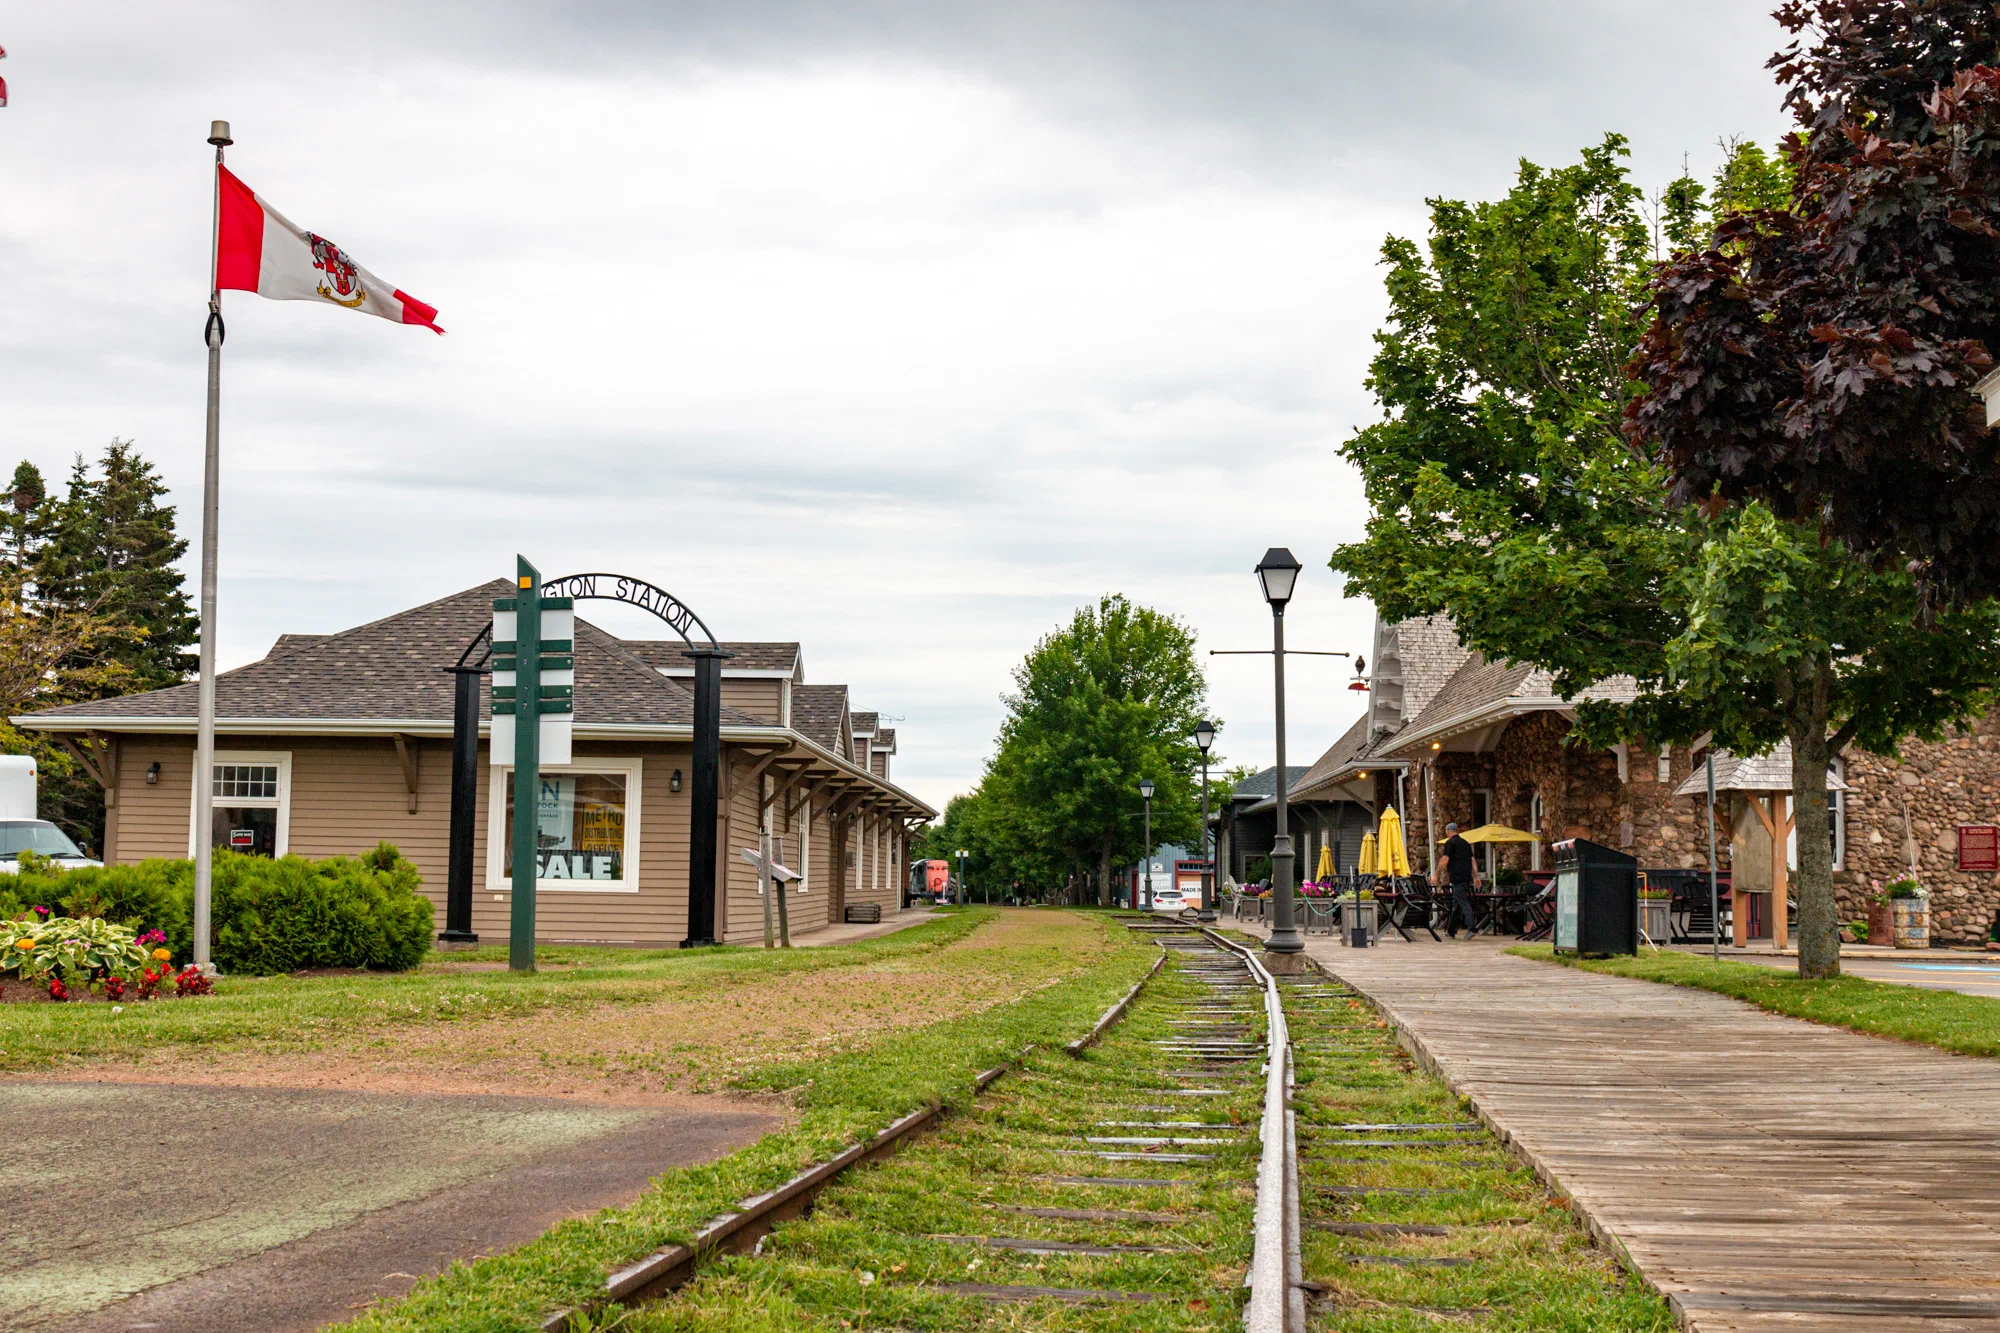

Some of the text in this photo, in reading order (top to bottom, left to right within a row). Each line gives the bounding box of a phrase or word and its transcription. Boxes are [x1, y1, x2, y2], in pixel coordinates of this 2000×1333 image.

[543, 575, 695, 635] GTON STATION
[585, 805, 623, 826] METRO
[585, 827, 622, 839] DISTRIBUTING
